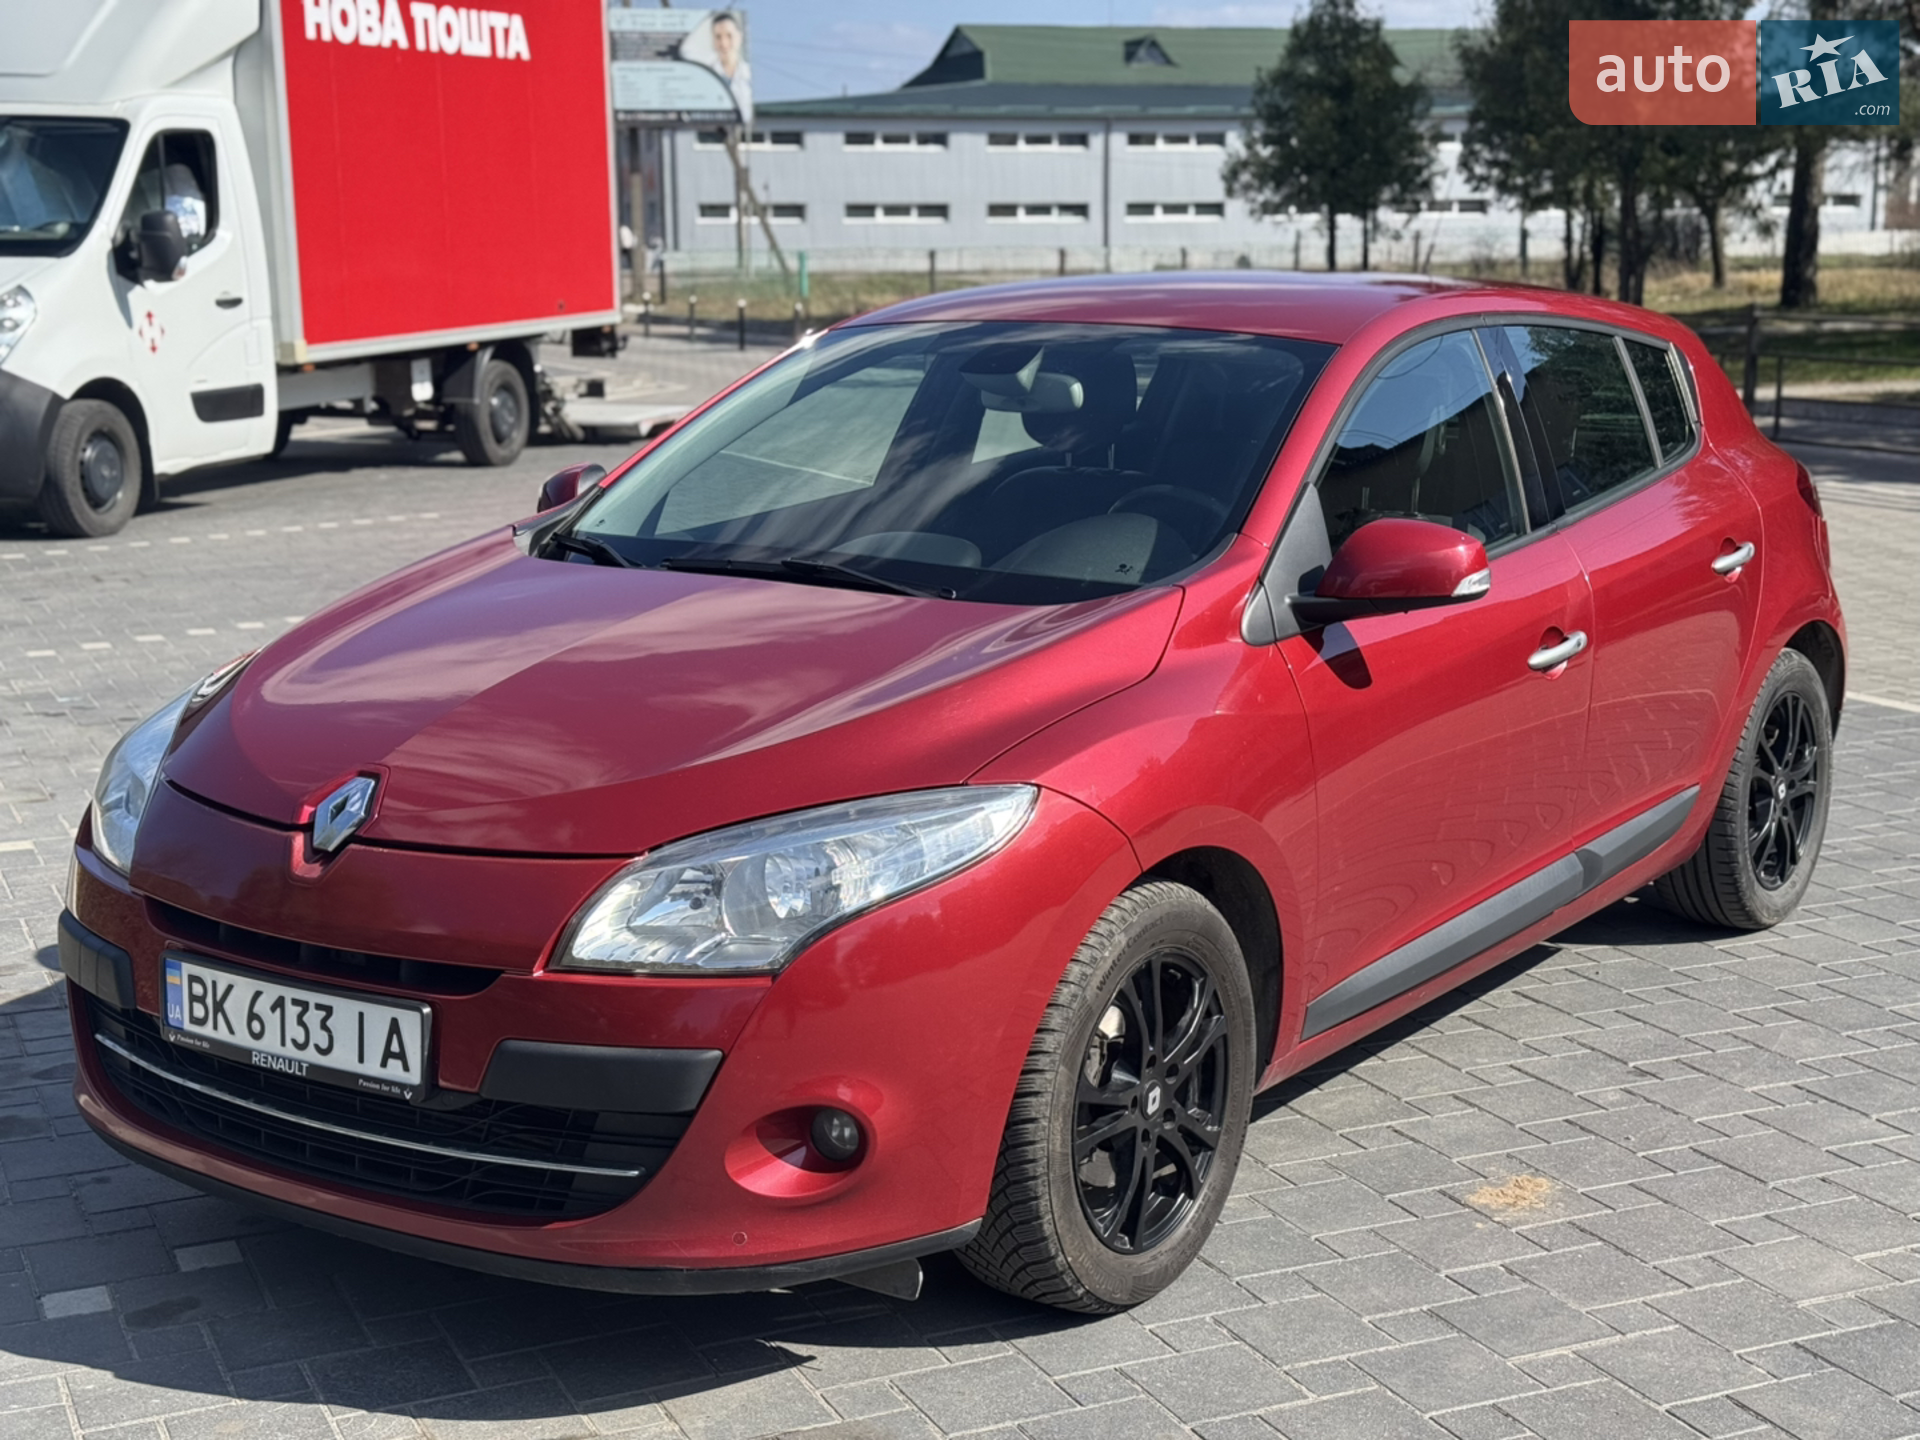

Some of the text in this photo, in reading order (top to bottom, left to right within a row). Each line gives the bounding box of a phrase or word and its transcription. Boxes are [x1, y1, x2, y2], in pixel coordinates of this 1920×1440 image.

[302, 0, 531, 61] НОВА ПОШТА
[167, 1002, 182, 1021] UA
[187, 974, 410, 1073] BK 6133 IA
[252, 1051, 309, 1076] RENAULT
